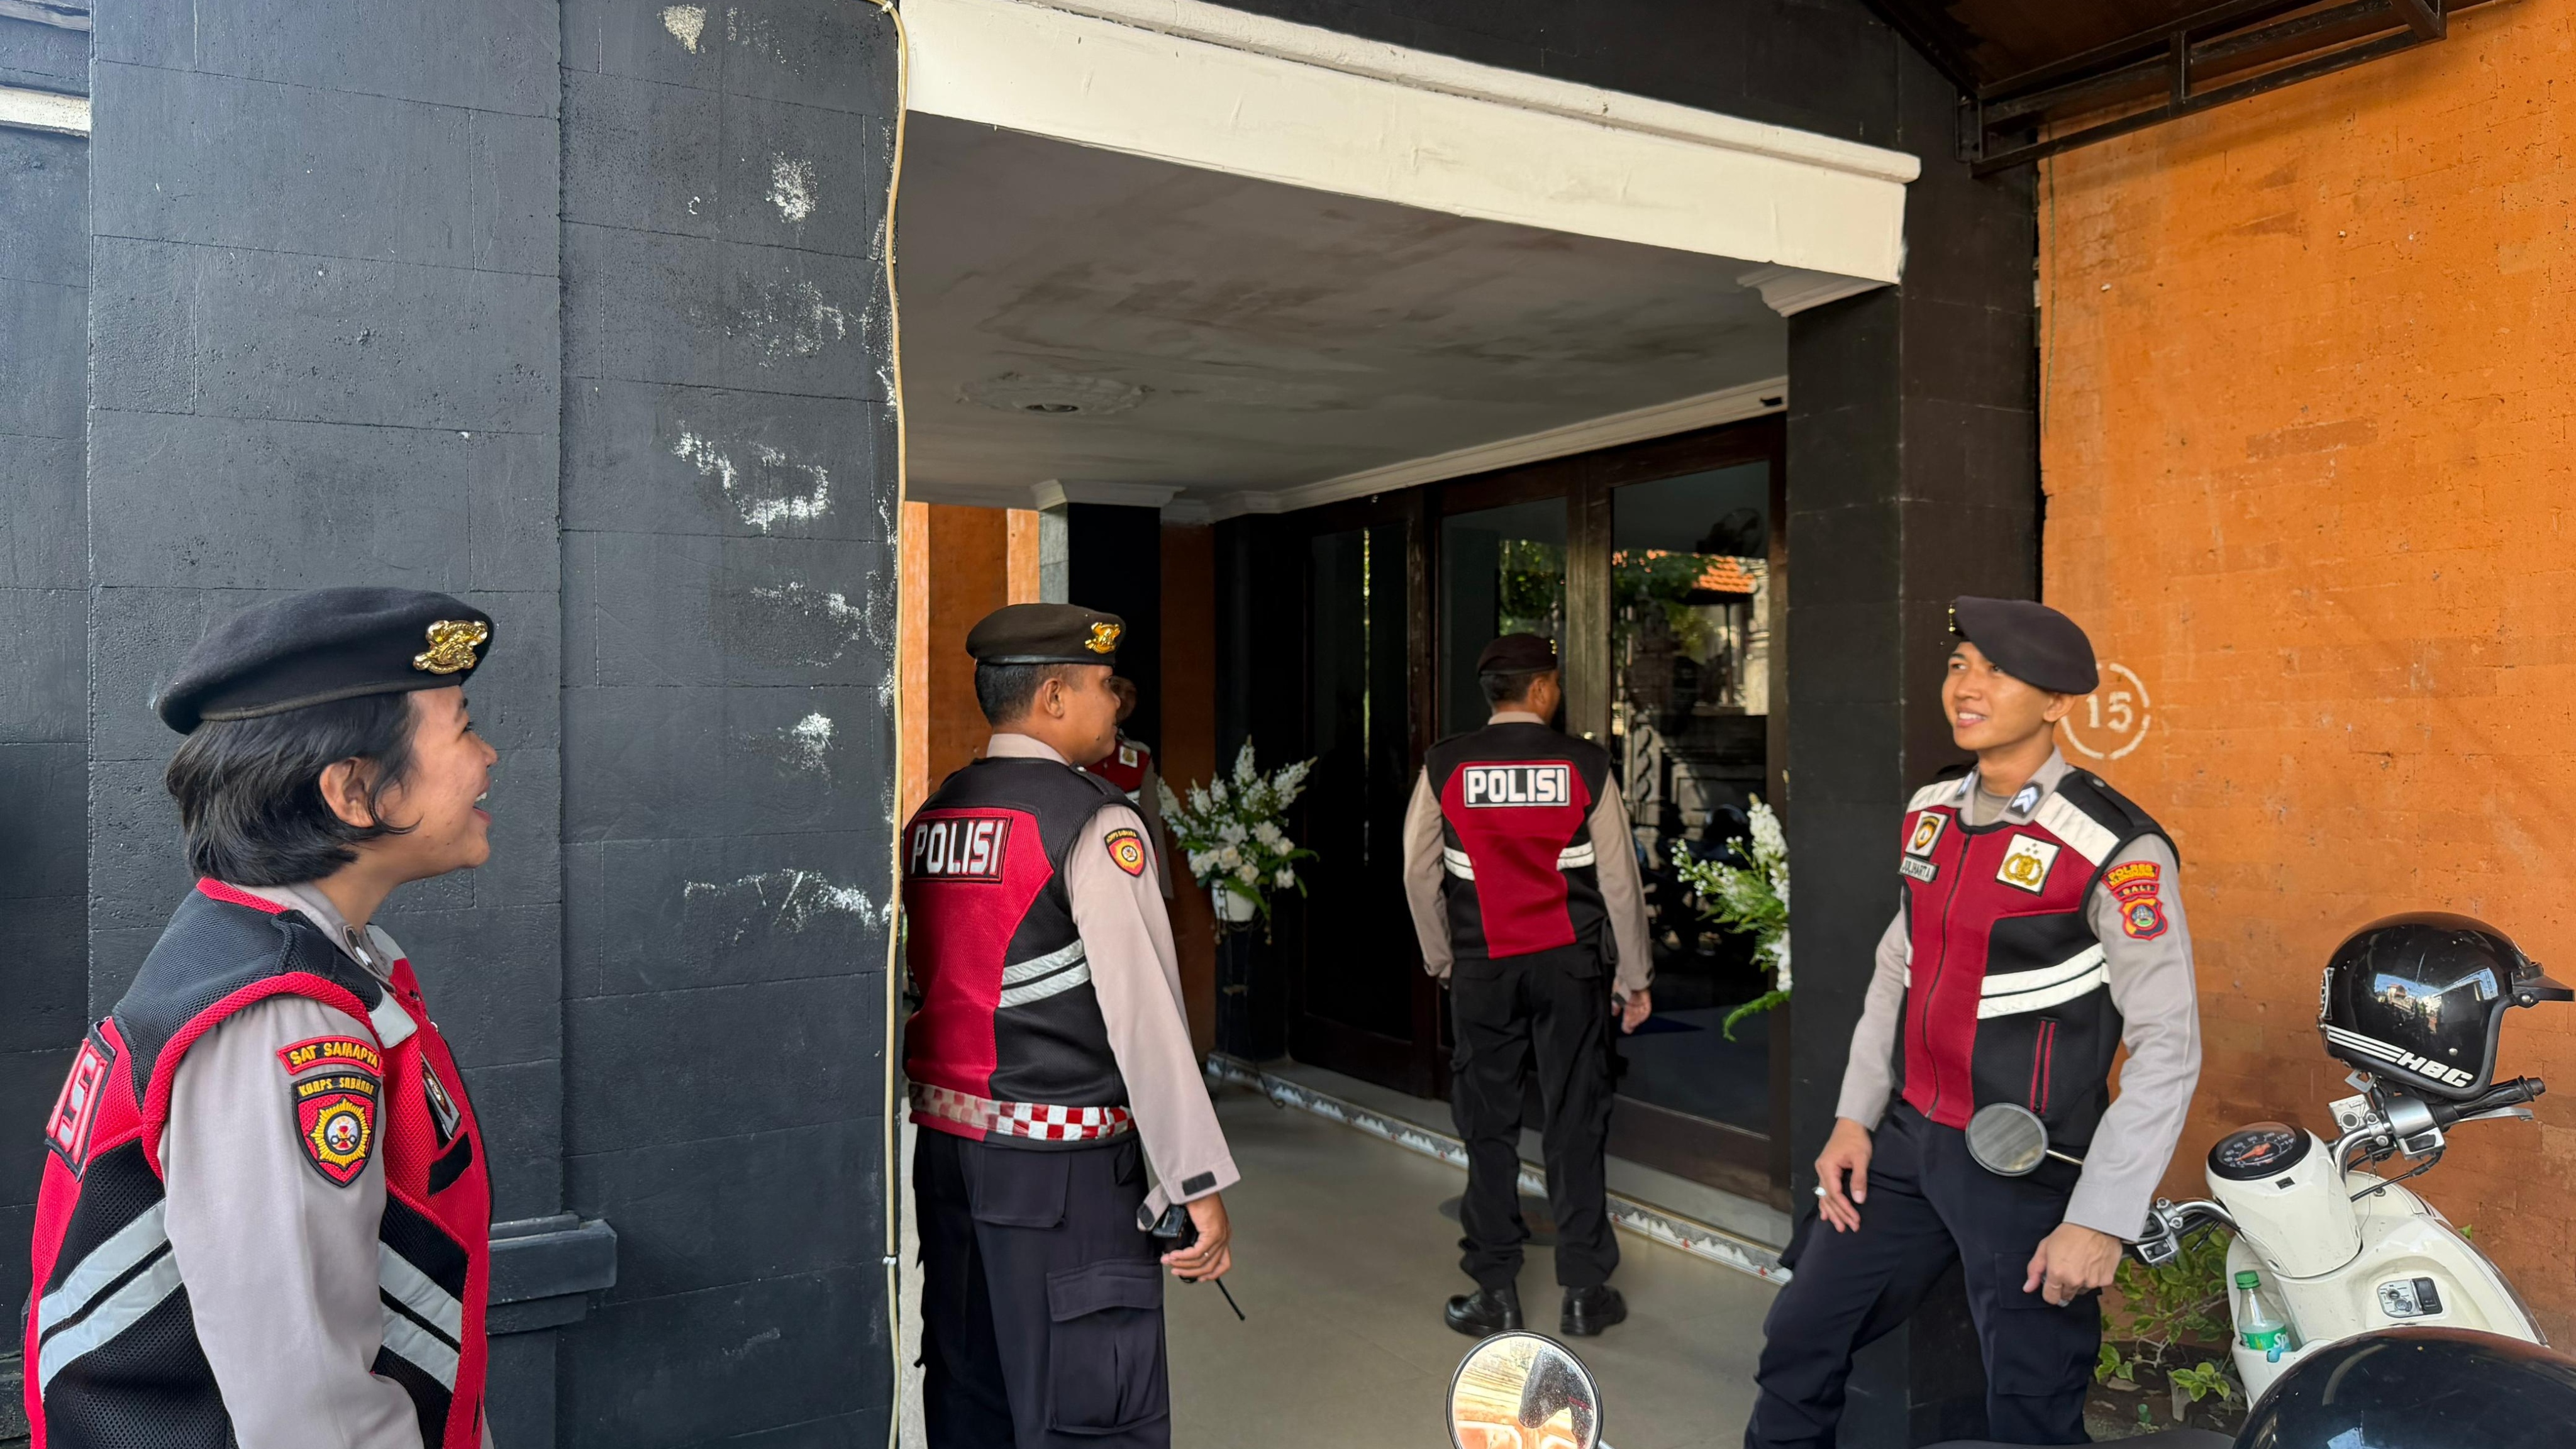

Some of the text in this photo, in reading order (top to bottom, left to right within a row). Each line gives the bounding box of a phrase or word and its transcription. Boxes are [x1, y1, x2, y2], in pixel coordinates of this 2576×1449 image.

[2086, 692, 2132, 733] 15
[1467, 769, 1565, 804] POLISI
[911, 819, 1004, 875] POLISI
[2123, 885, 2150, 895] BALI
[289, 1042, 378, 1068] SAT SAMAPTA
[2397, 1052, 2473, 1087] HBC
[299, 1078, 333, 1096] KORPS
